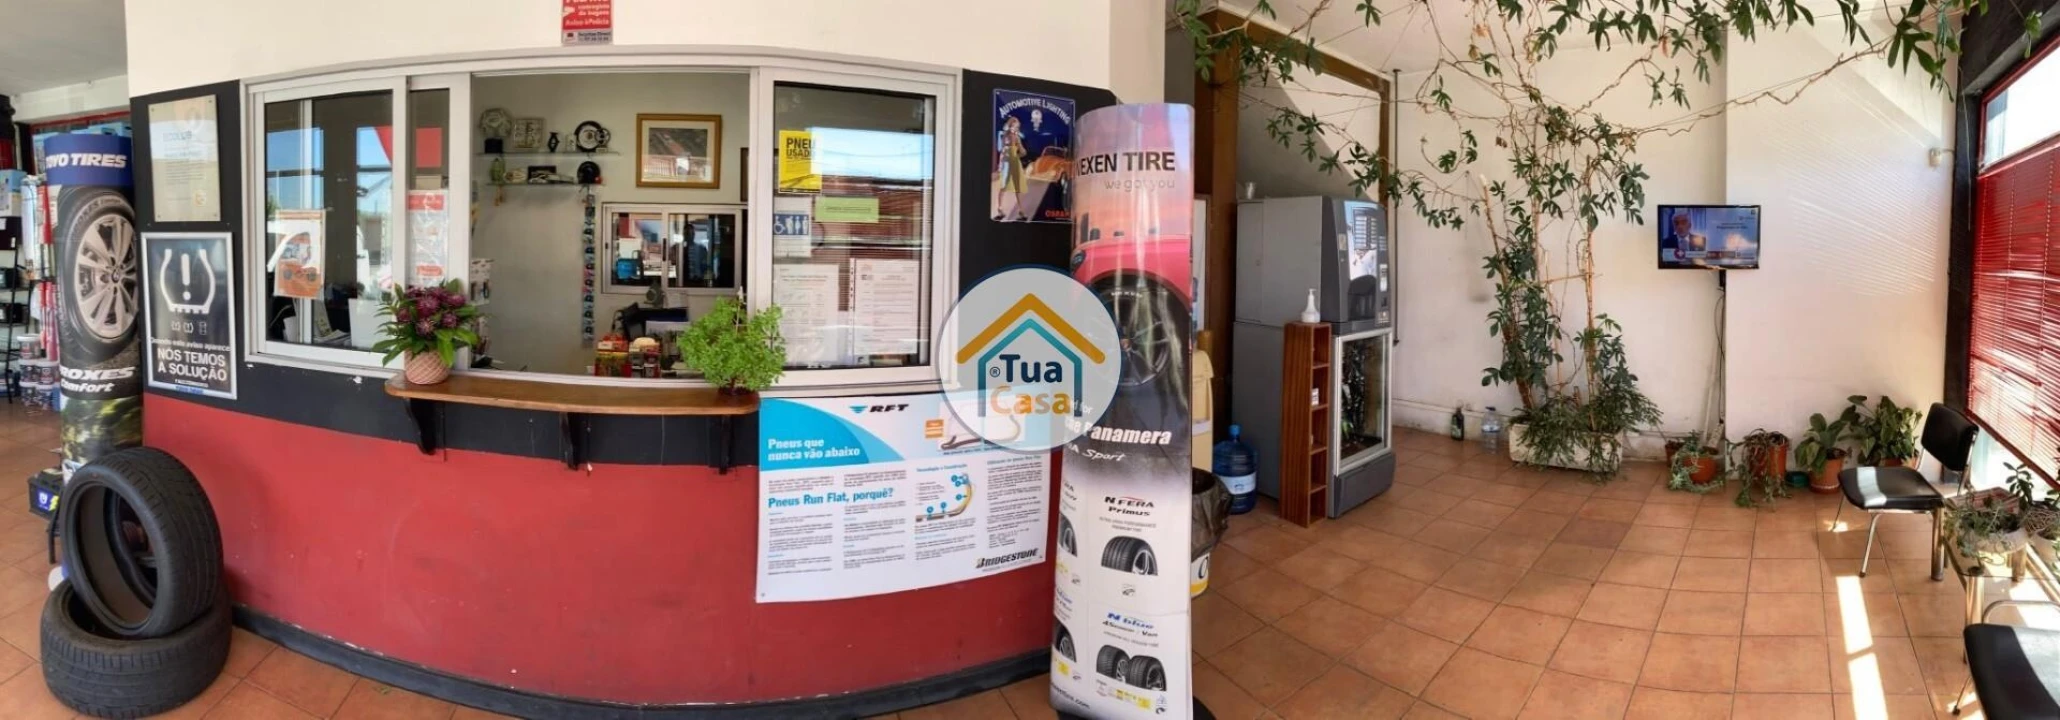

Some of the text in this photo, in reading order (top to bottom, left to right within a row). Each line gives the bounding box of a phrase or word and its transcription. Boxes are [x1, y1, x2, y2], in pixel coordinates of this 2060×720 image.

[70, 153, 127, 169] TIRES
[1123, 151, 1175, 172] TIRE
[1104, 180, 1121, 190] we
[1149, 179, 1175, 194] you
[183, 350, 226, 367] TEMOS
[168, 362, 227, 381] SOLUÇÃO
[870, 404, 909, 412] RFT
[767, 438, 825, 449] Pneus que
[767, 446, 861, 461] nunca vão abaixo
[1082, 448, 1127, 462] Sport
[767, 487, 894, 508] Pneus Run Flat, porquê?
[1118, 499, 1155, 508] FERA
[1108, 506, 1151, 516] Primus
[976, 548, 1038, 568] BRIDGESTONE
[1123, 618, 1154, 629] blue
